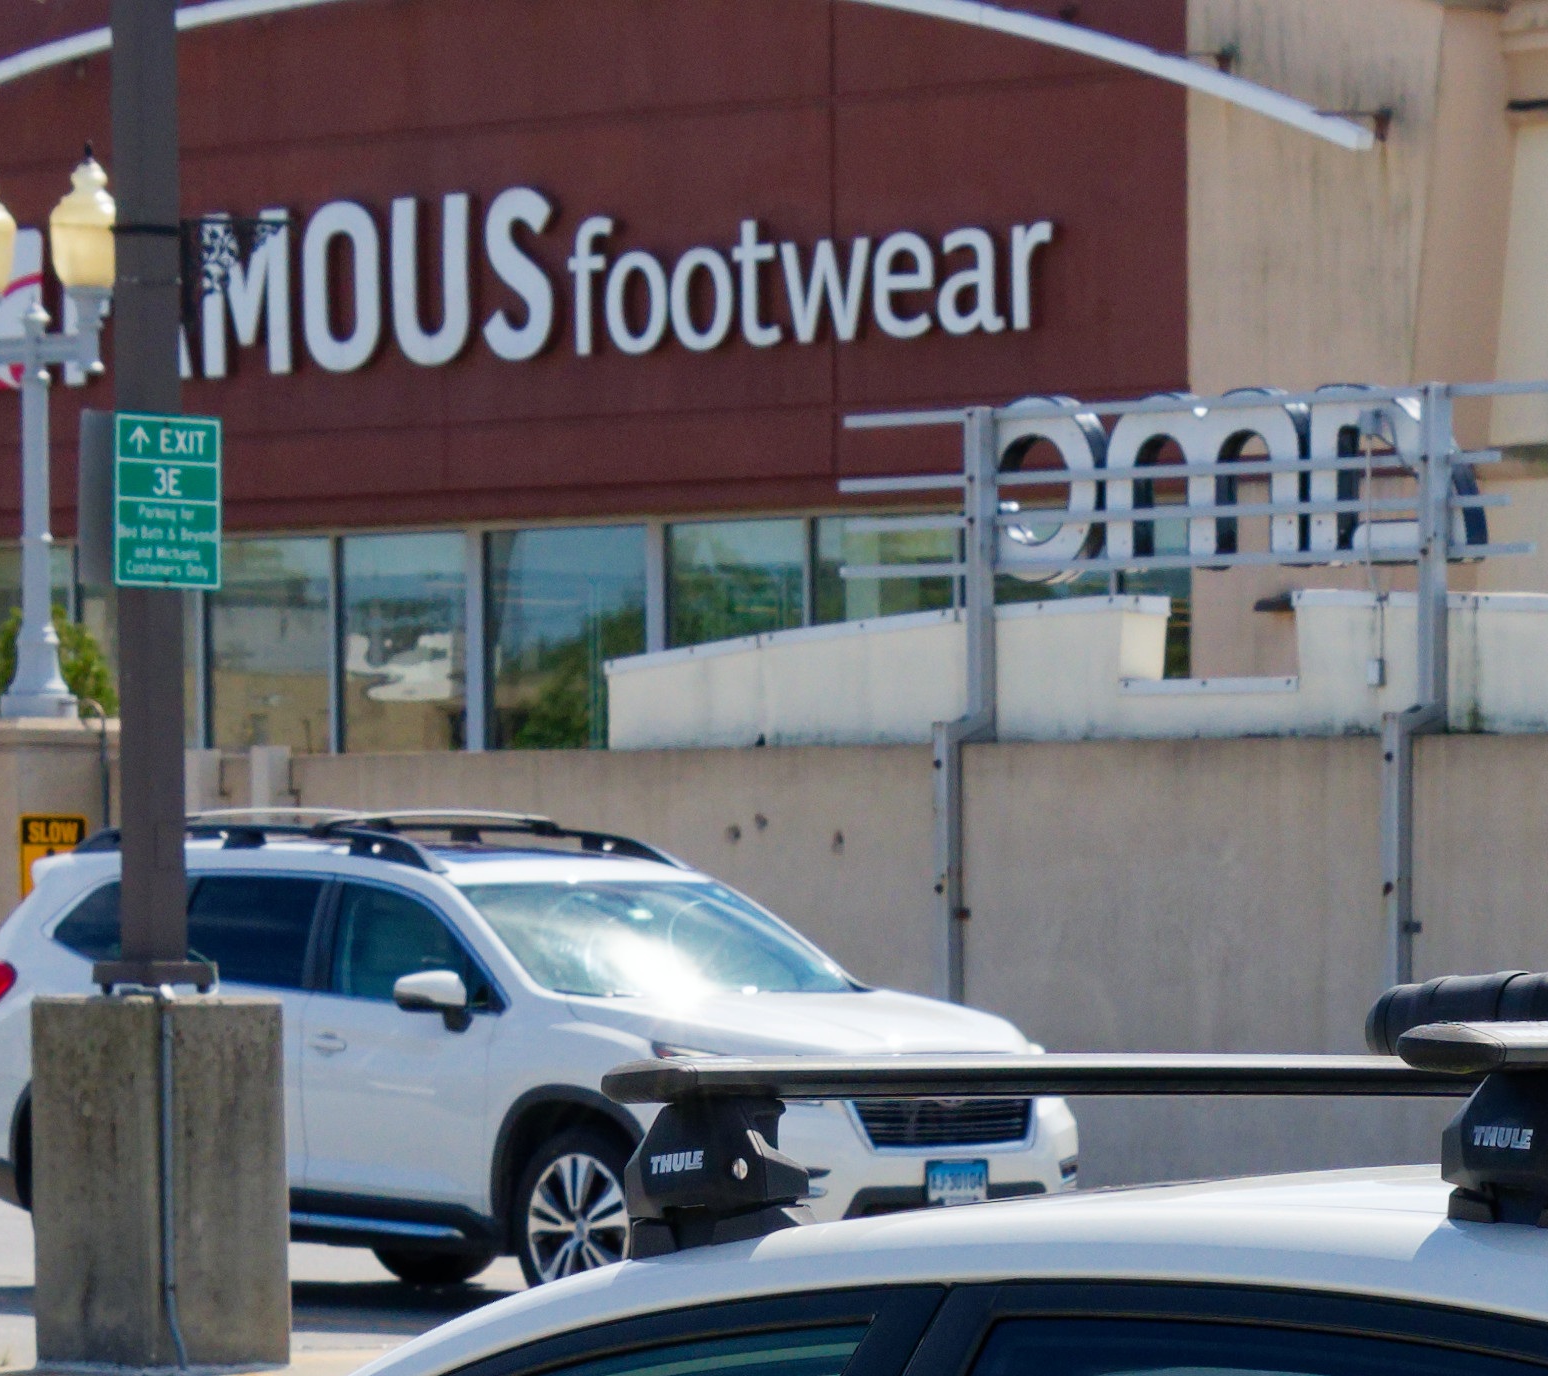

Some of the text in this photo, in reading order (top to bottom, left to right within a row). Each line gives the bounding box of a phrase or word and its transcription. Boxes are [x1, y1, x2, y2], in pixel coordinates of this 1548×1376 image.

[64, 187, 1053, 388] MOUS footwear
[160, 428, 206, 455] EXIT
[153, 467, 182, 497] 3E
[138, 503, 177, 522] Parking
[126, 560, 182, 576] Customers
[27, 821, 79, 843] SLOW
[1473, 1125, 1534, 1150] THULE
[650, 1150, 705, 1175] THULE
